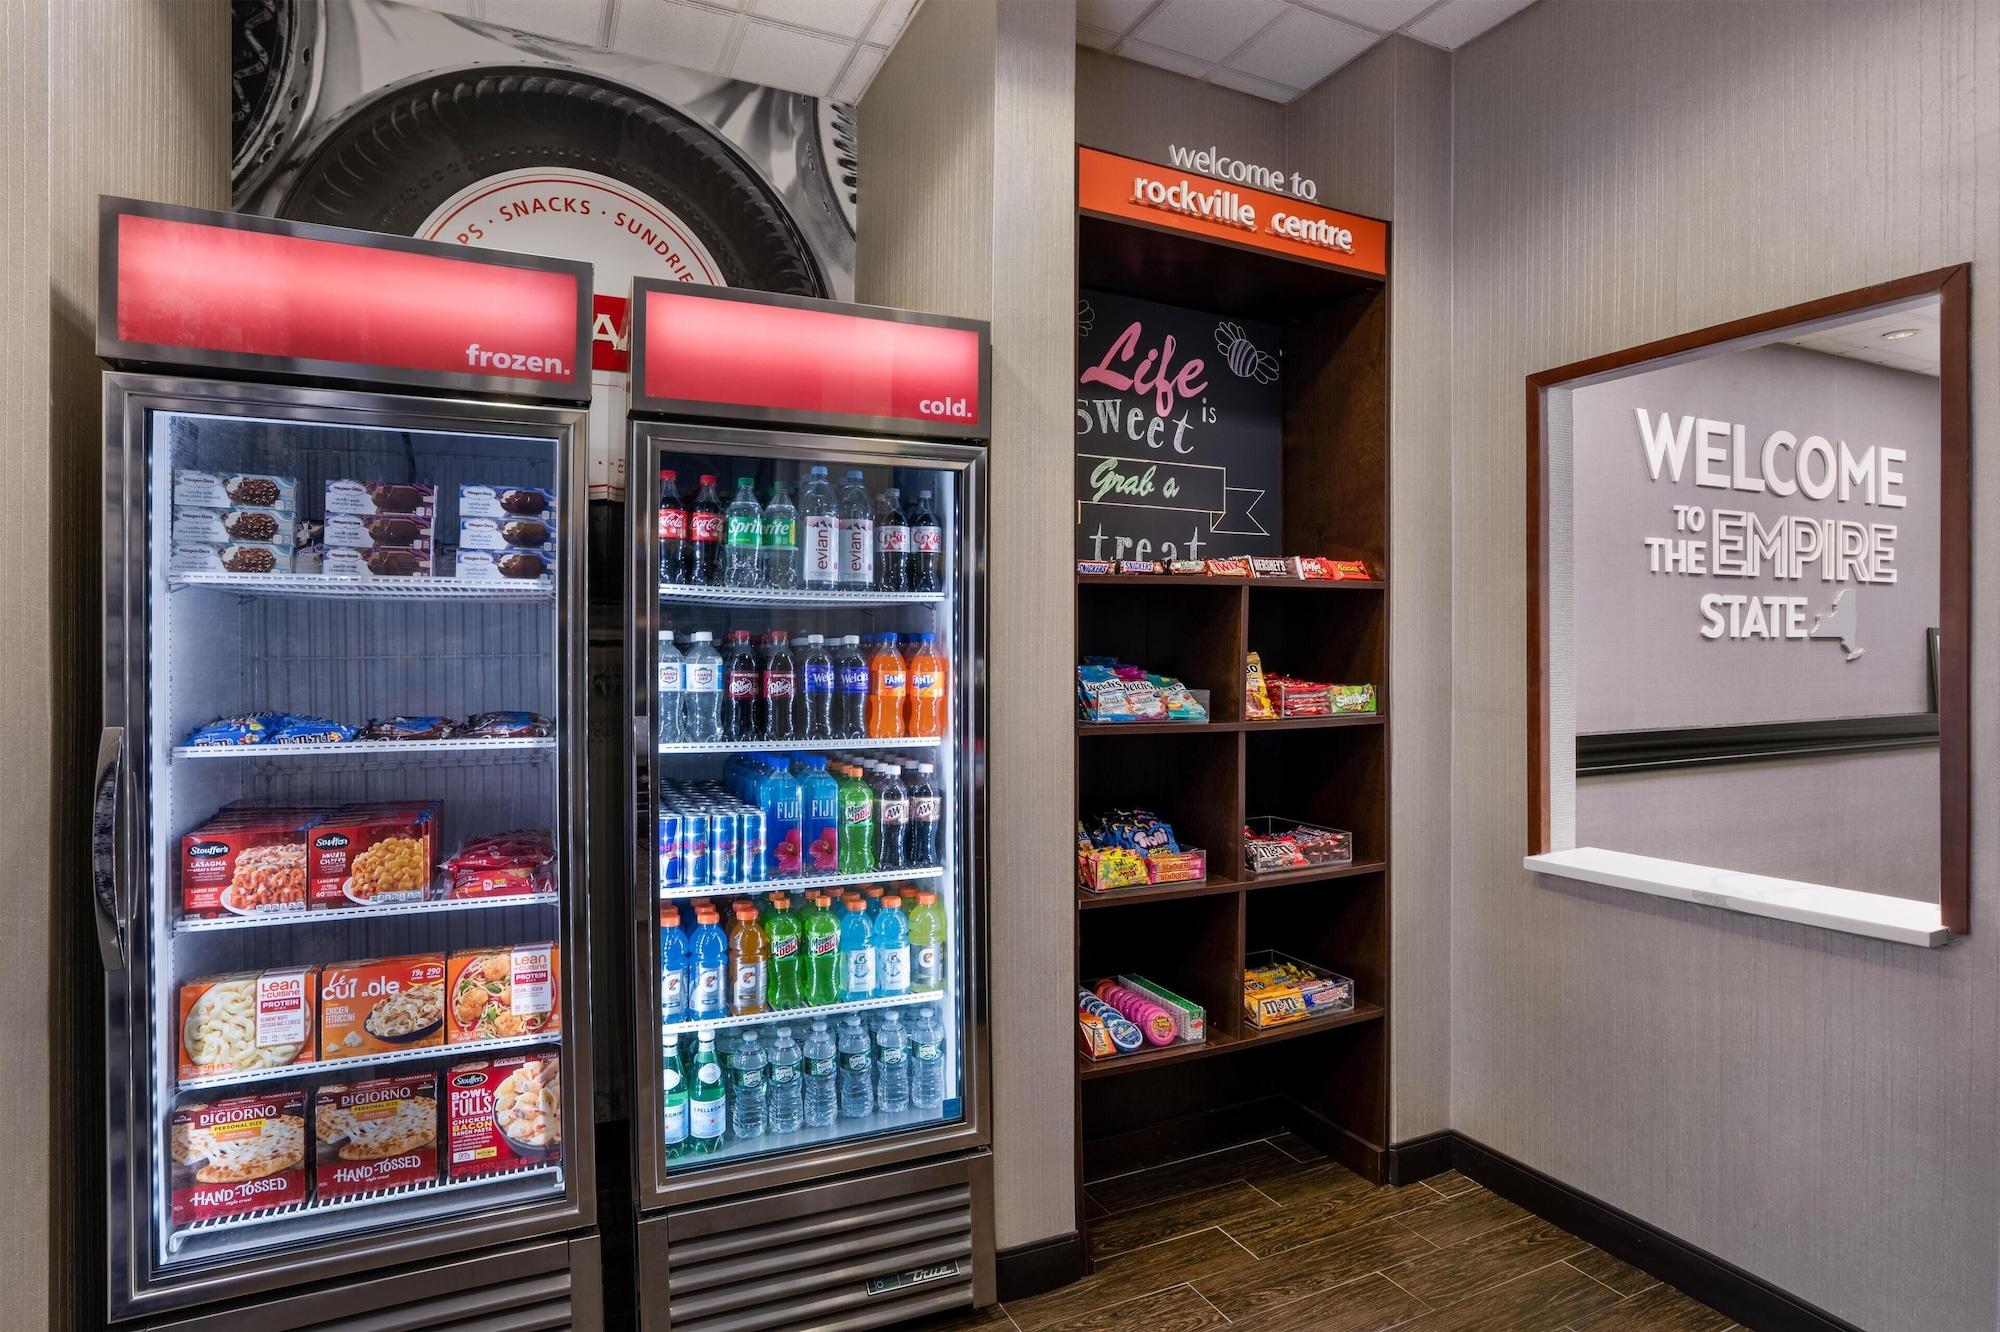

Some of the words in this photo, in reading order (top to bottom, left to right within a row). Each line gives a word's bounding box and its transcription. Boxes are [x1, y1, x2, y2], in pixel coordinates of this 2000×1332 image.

[1168, 144, 1284, 192] welcome
[1291, 171, 1317, 200] to
[499, 196, 592, 222] SNACKS
[1134, 177, 1256, 225] rockville
[1270, 211, 1353, 250] centre
[465, 343, 570, 375] frozen.
[1080, 321, 1208, 417] Life
[919, 396, 972, 418] cold.
[1202, 397, 1217, 424] is
[1633, 407, 1907, 508] WELCOME
[1090, 458, 1157, 503] Grab
[1162, 477, 1180, 498] a
[1673, 504, 1706, 532] TO
[816, 529, 828, 570] evian
[849, 532, 862, 571] evian
[1644, 536, 1708, 575] THE
[1712, 508, 1898, 585] EMPIRE
[1699, 593, 1809, 640] STATE
[777, 801, 800, 819] FIJI
[812, 799, 834, 817] FIJI
[189, 844, 229, 856] Stouffer's
[191, 860, 227, 869] LASAGNA
[515, 954, 547, 965] Lean
[261, 980, 300, 992] Lean
[515, 972, 547, 980] PROTEIN
[262, 998, 299, 1008] PROTEIN
[456, 1074, 484, 1086] Stouffer's
[354, 1103, 385, 1112] PERSONAL
[451, 1096, 492, 1118] FULLS
[214, 1122, 248, 1132] PERSONAL
[452, 1115, 493, 1126] CHICKEN
[452, 1120, 493, 1132] BACON
[332, 1155, 421, 1183] HAND-TOSSED
[189, 1177, 288, 1207] HAND-TOSSED
